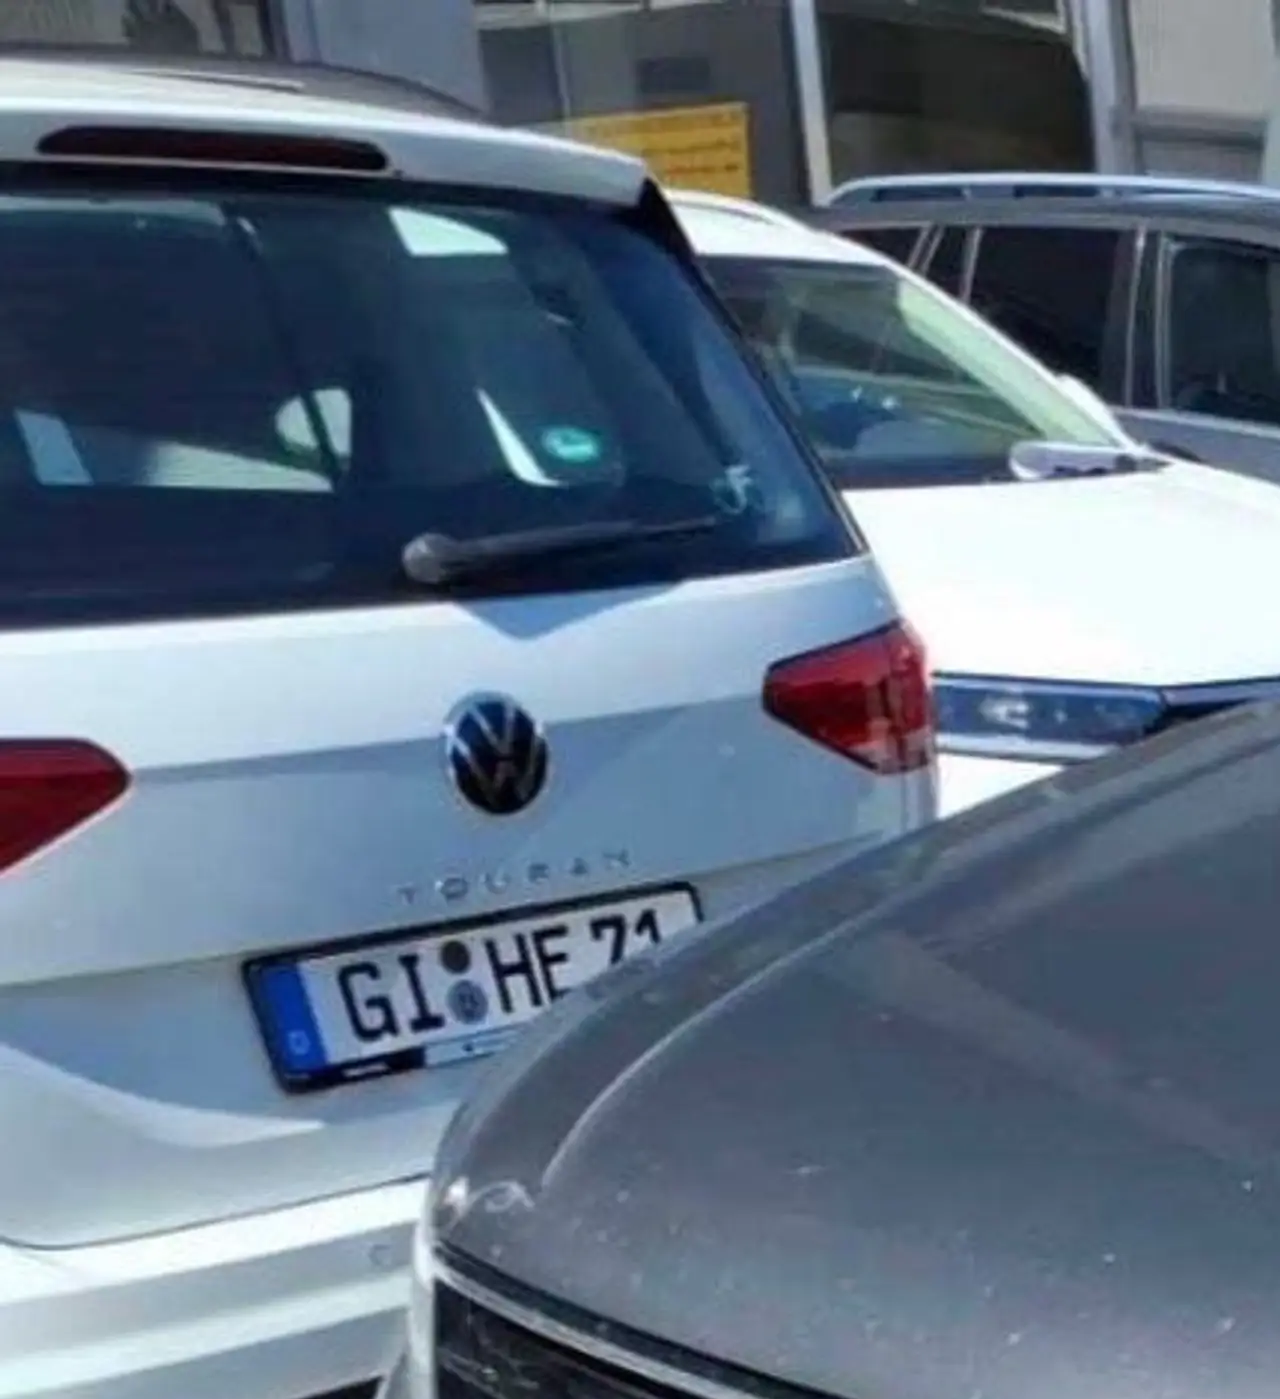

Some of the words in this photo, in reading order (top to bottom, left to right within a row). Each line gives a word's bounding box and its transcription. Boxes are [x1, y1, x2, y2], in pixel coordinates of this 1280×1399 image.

[398, 848, 631, 905] TOURAN
[338, 953, 445, 1043] GI
[484, 925, 570, 1014] HE
